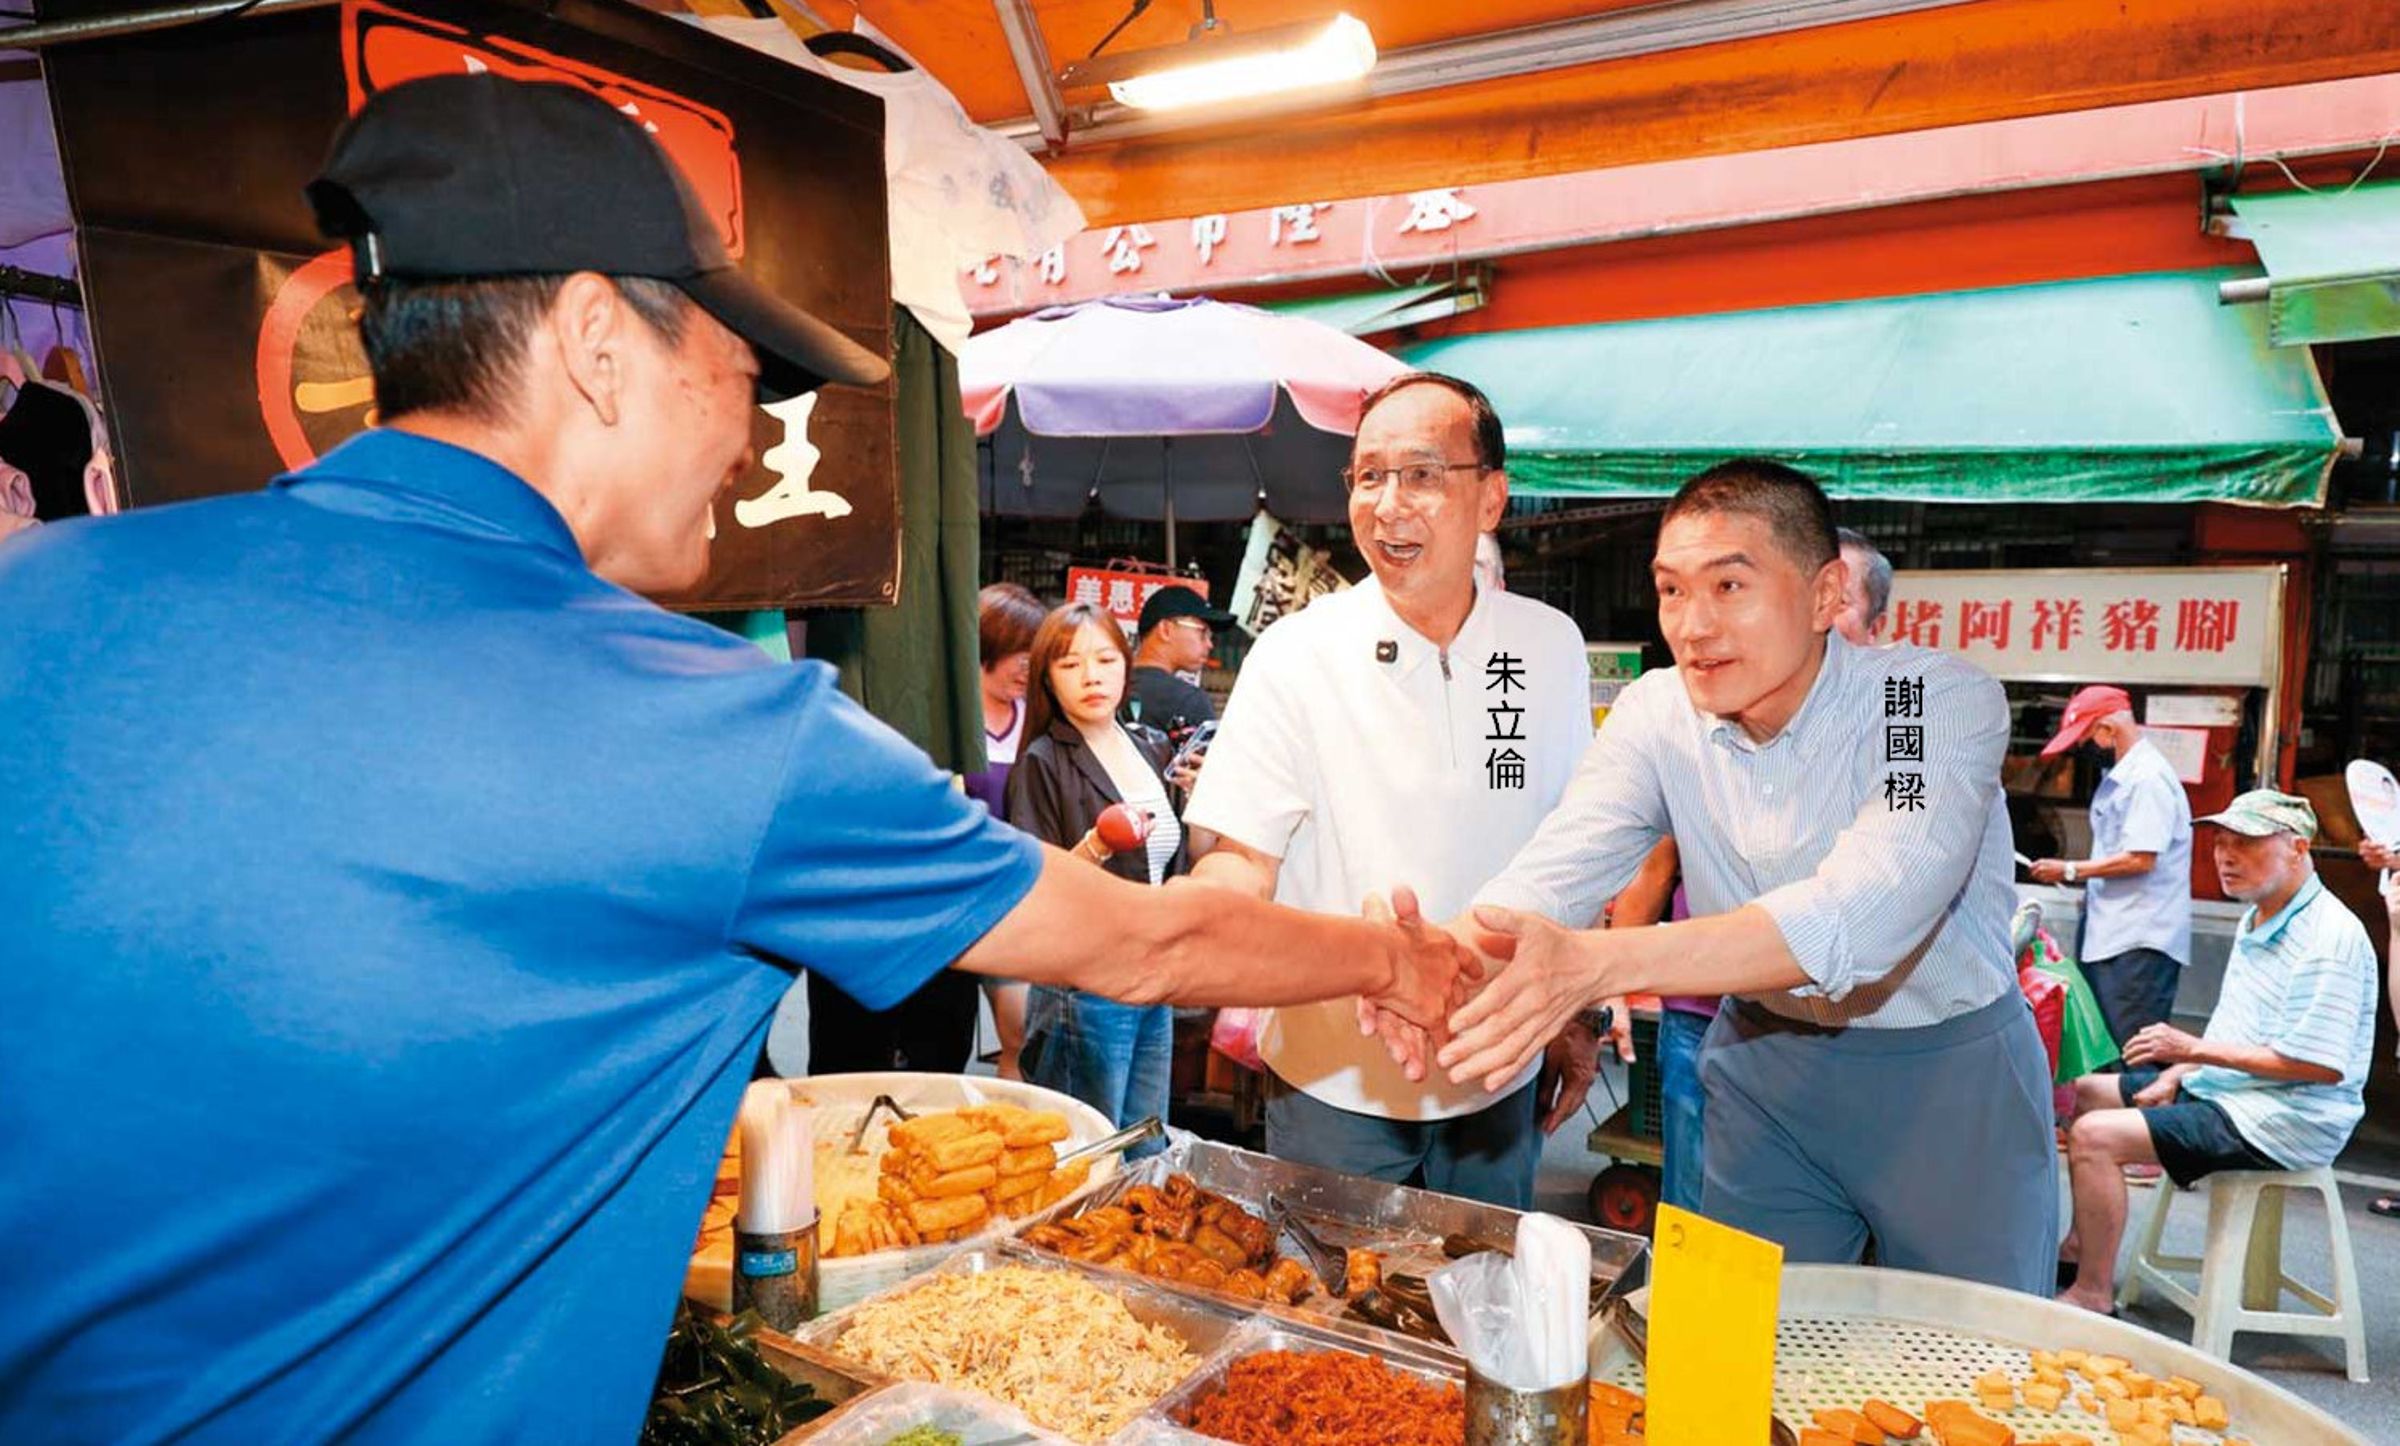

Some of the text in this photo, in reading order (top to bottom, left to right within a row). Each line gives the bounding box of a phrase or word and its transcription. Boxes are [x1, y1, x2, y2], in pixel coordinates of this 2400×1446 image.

[1872, 598, 2241, 653] 堵阿祥豬腳
